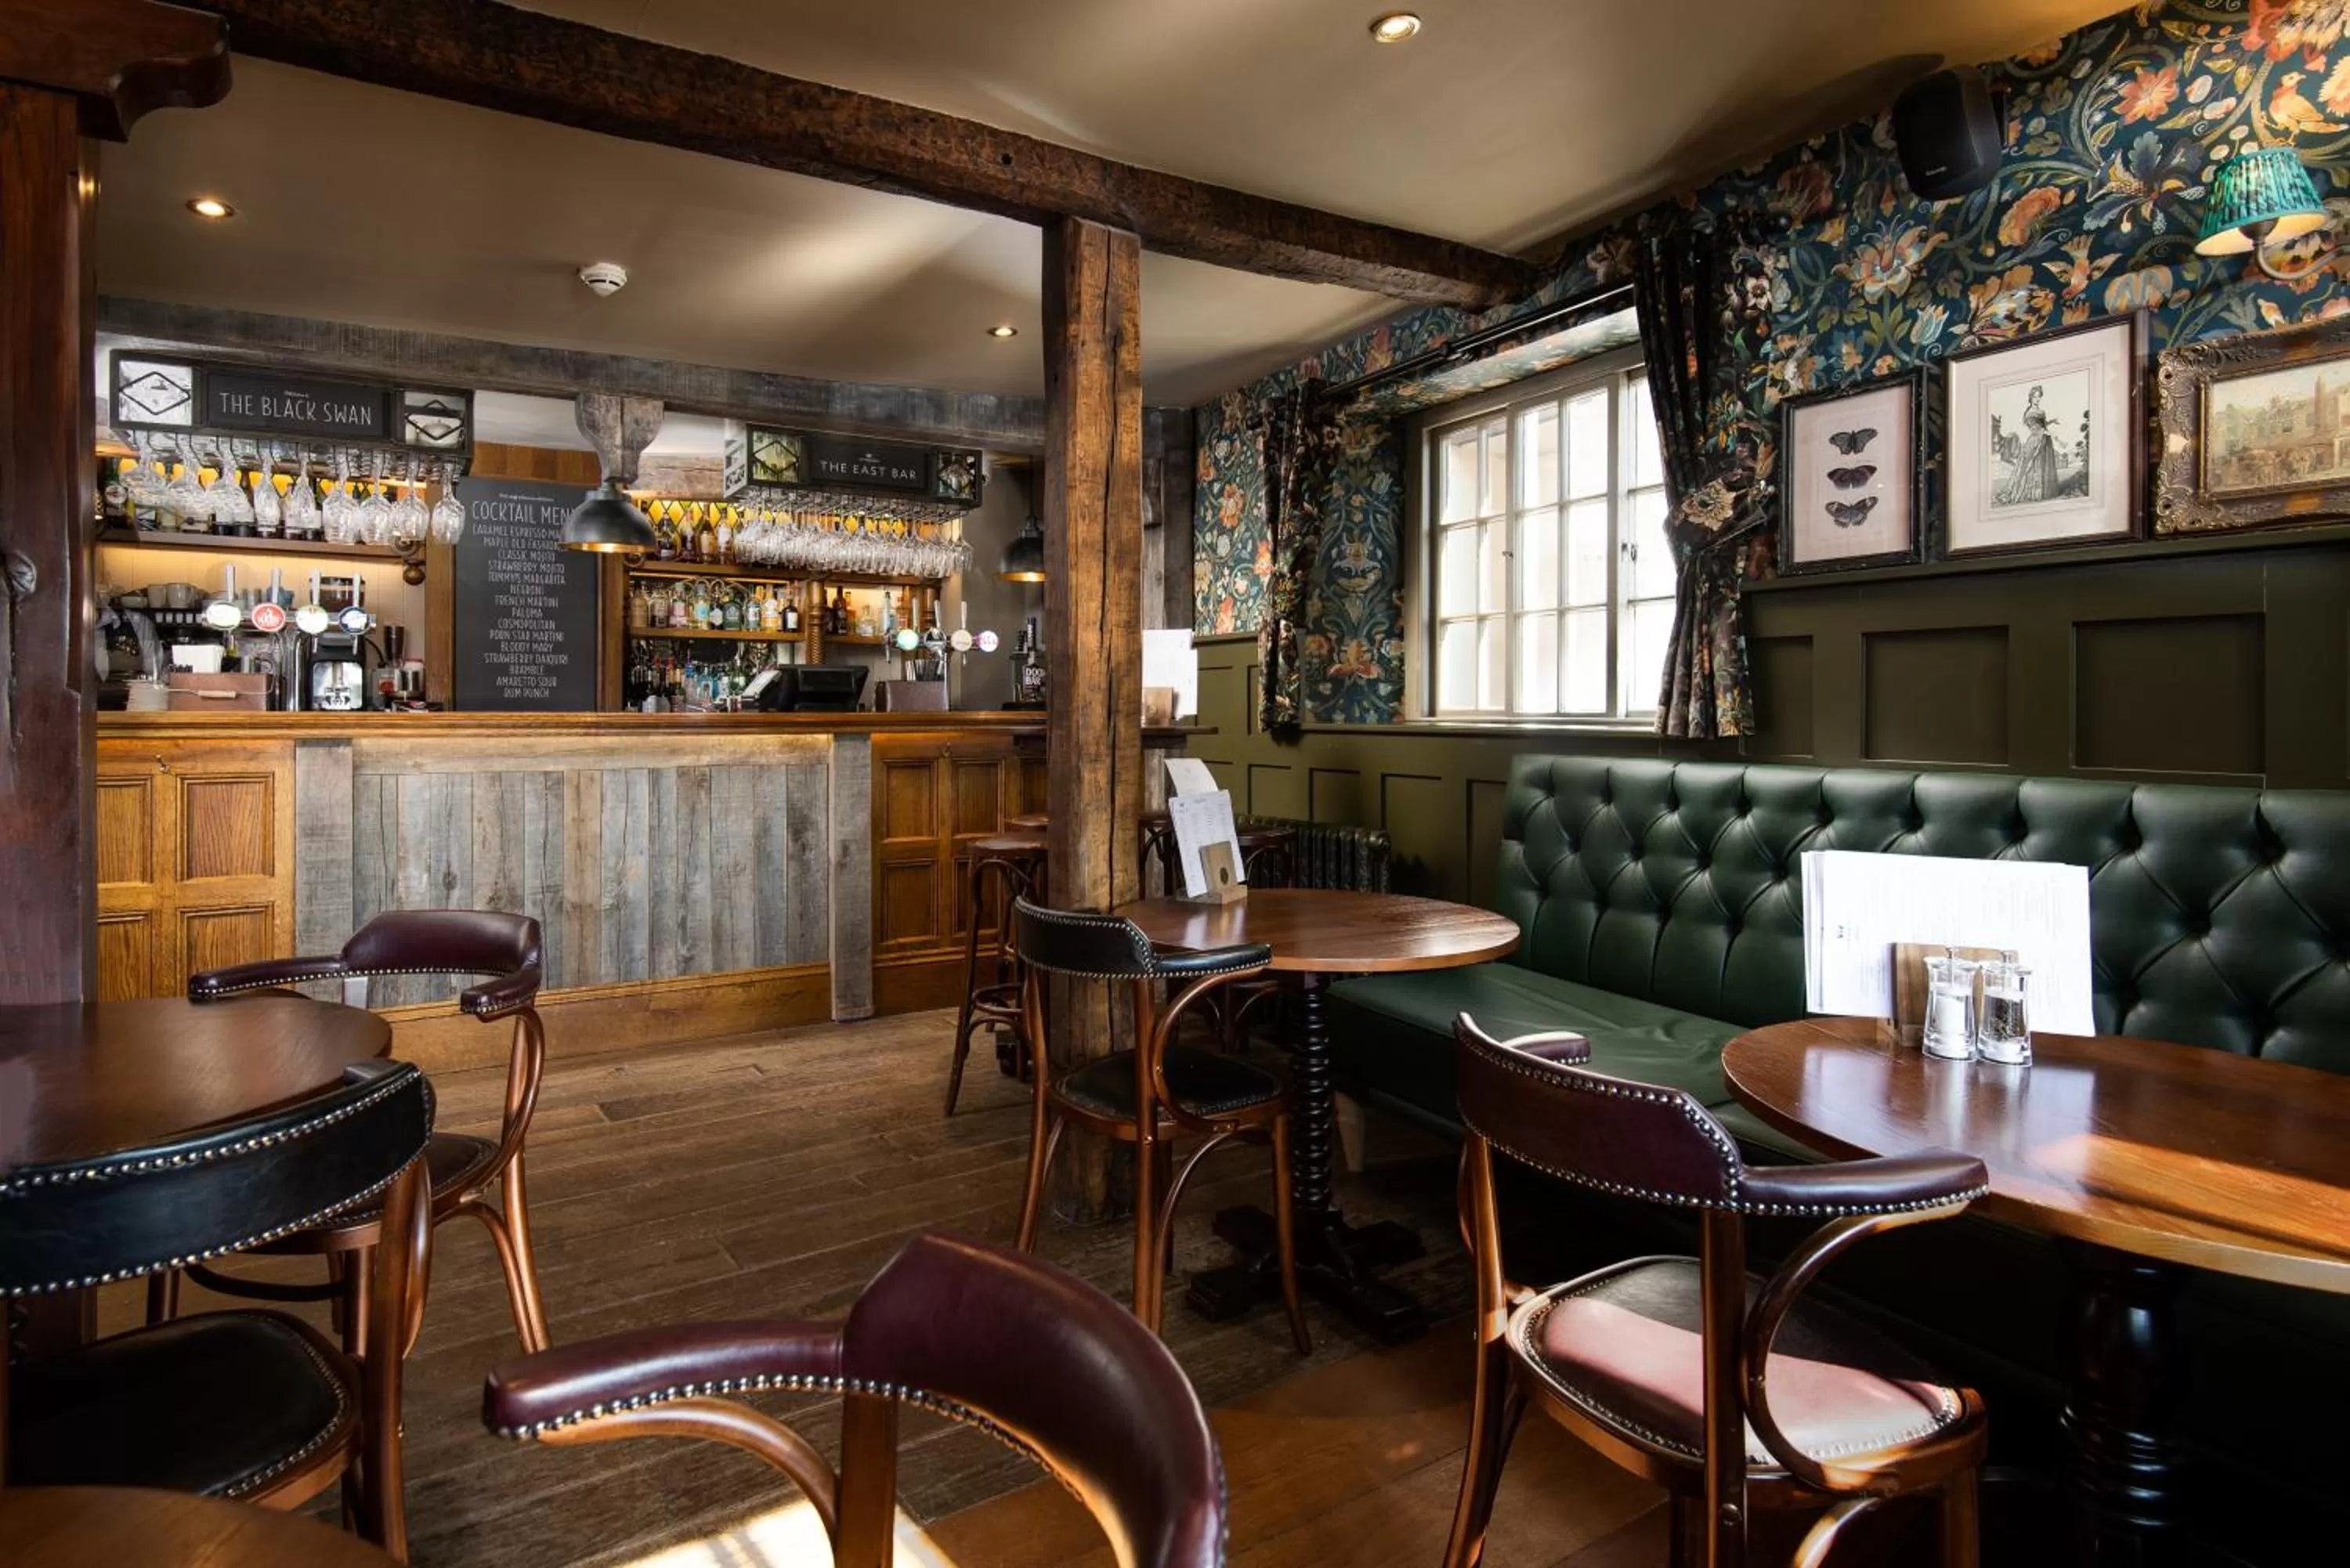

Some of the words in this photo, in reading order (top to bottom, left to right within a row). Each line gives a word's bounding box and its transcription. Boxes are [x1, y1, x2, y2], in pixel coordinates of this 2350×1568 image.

[219, 392, 255, 416] THE
[261, 396, 316, 421] BLACK
[323, 401, 372, 425] SWAN
[820, 460, 847, 474] THE
[852, 463, 885, 477] EAST
[891, 468, 916, 480] BAR
[472, 500, 537, 525] COCKTAIL
[540, 505, 573, 526] MEN
[488, 559, 537, 572] STRAWBERRY
[1025, 676, 1041, 685] BAR
